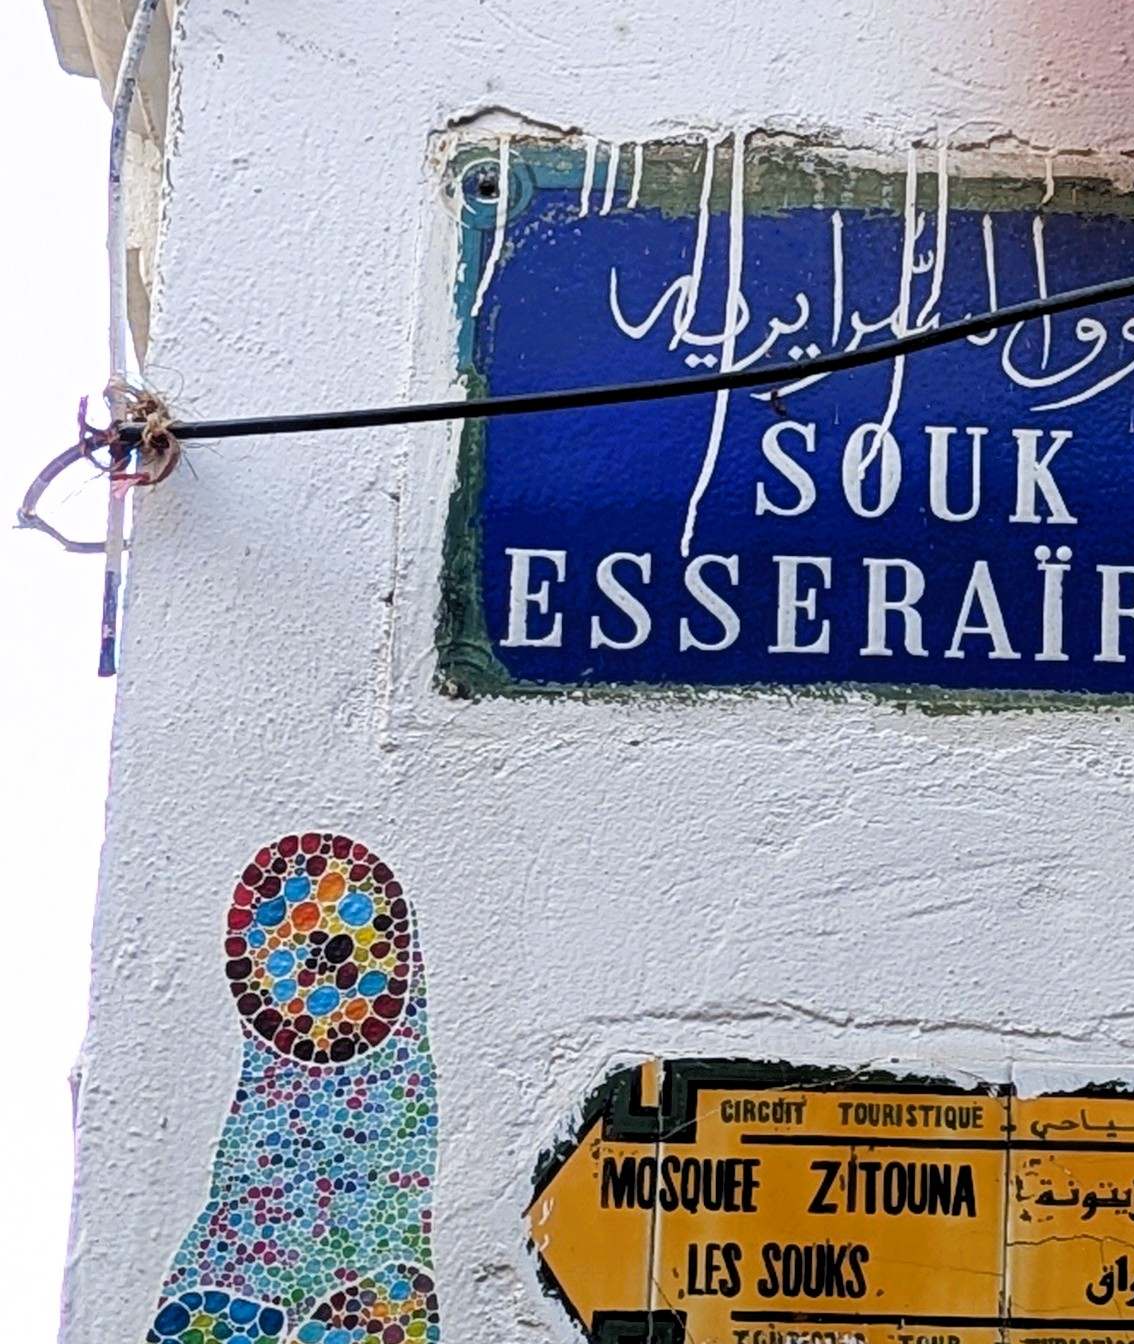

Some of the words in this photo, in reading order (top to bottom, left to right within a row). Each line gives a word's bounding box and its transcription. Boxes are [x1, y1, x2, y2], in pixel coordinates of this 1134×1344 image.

[756, 421, 1077, 523] SOUK
[721, 1097, 806, 1124] CIRCUIT
[838, 1103, 983, 1130] TOURISTIQUE
[601, 1156, 760, 1214] MOSQUEE
[808, 1161, 976, 1217] ZITOUNA
[688, 1243, 741, 1297] LES
[758, 1243, 869, 1298] SOUKS
